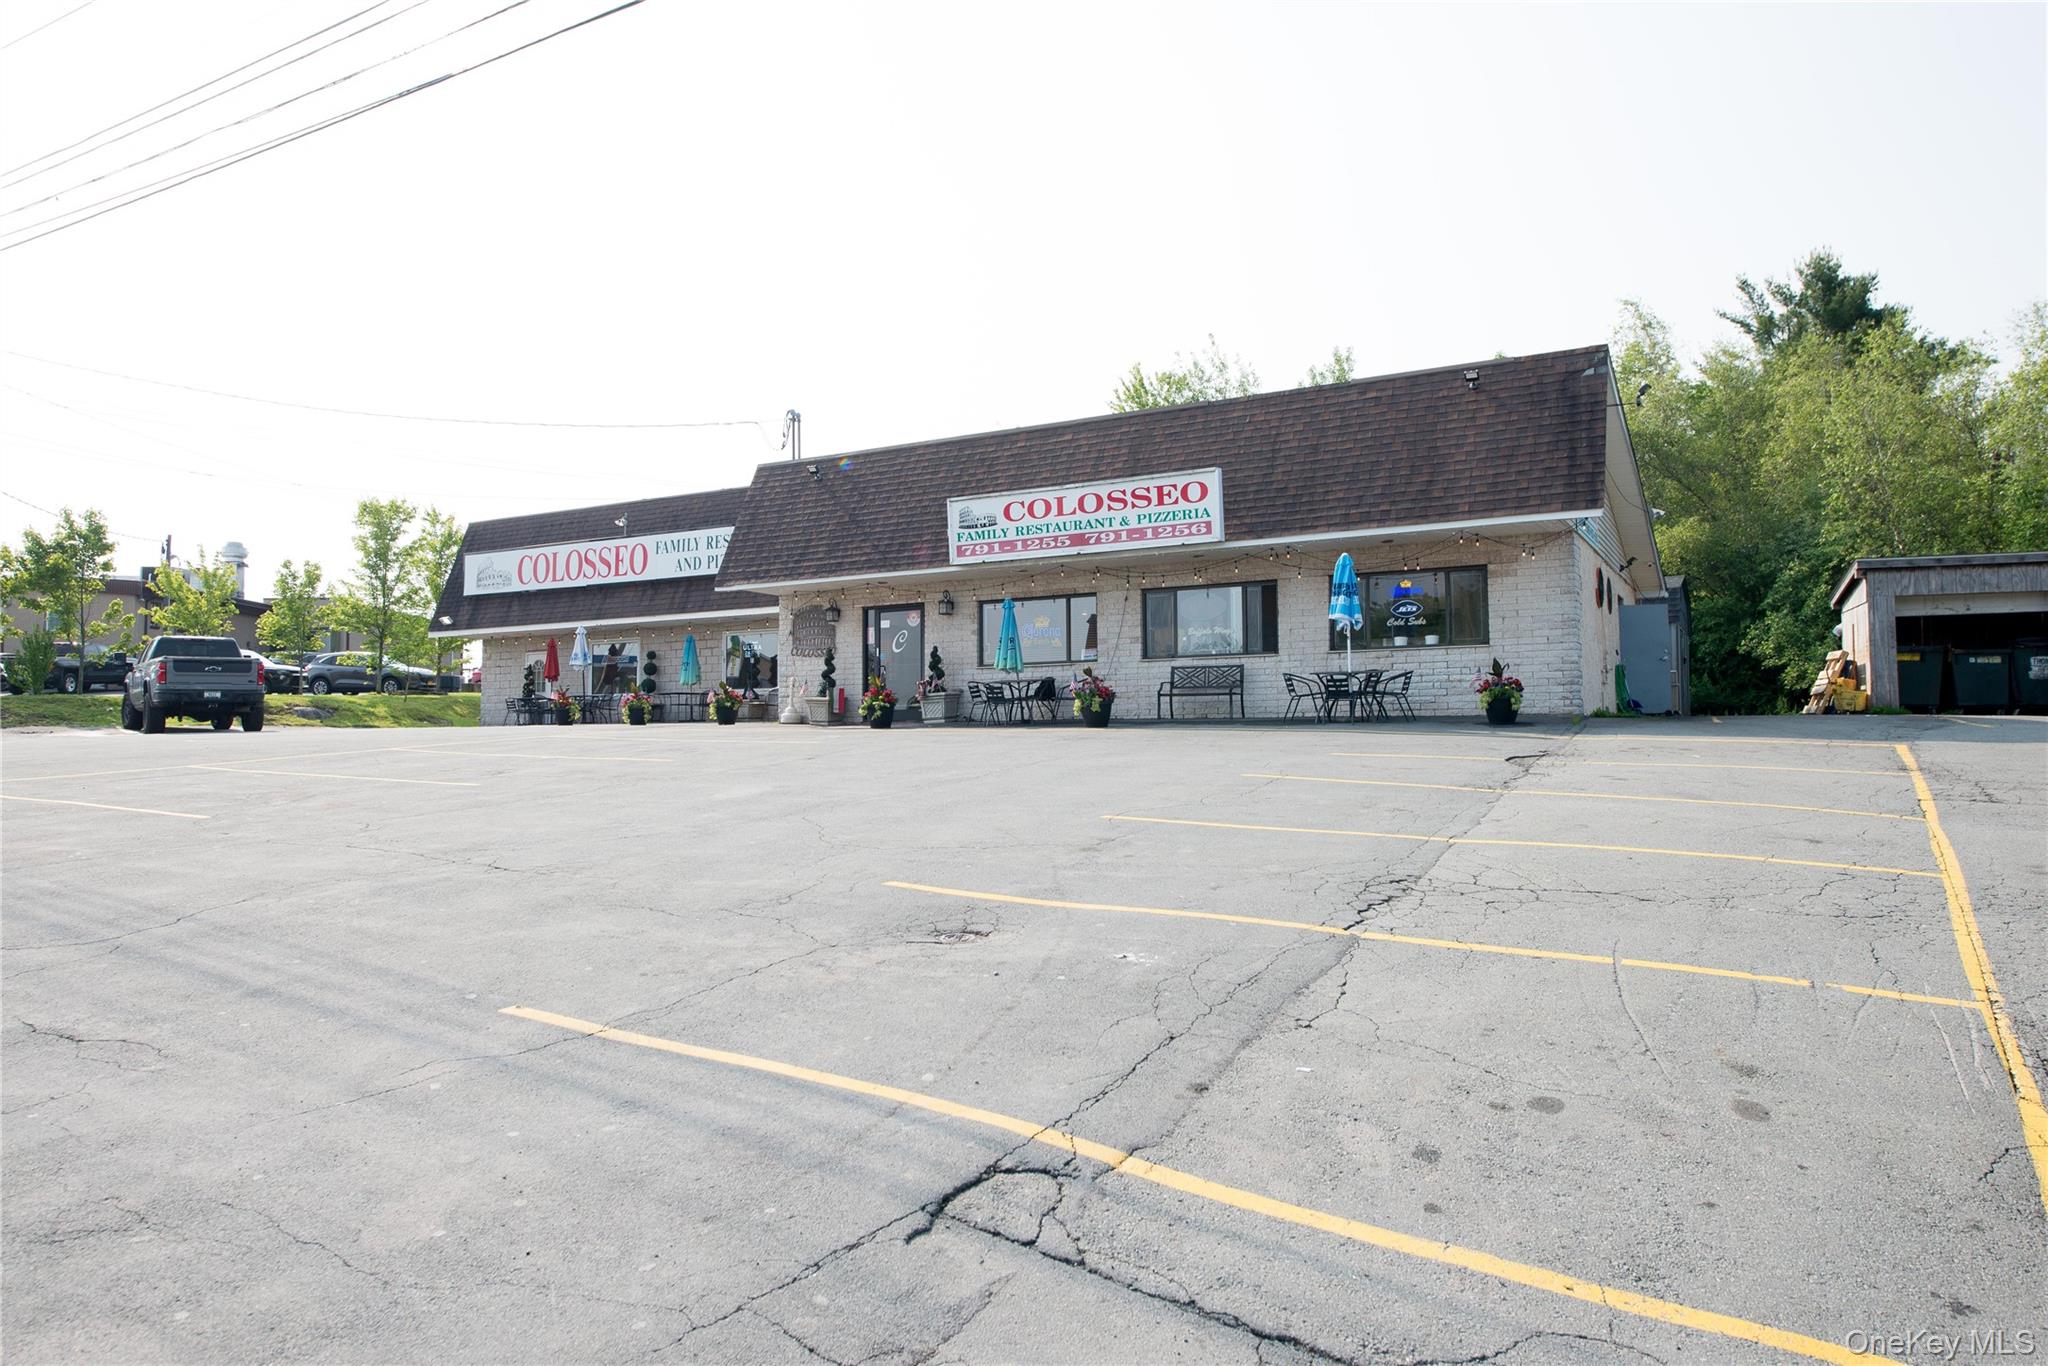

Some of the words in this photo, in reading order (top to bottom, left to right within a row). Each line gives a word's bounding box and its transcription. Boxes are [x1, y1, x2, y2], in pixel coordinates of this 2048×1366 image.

[1003, 481, 1208, 522] COLOSSEO
[957, 528, 1010, 542] FAMILY
[1016, 516, 1115, 536] RESTAURANT
[1119, 515, 1130, 526] &
[1137, 507, 1211, 524] PIZZERIA
[961, 536, 1071, 556] 791-1255
[1084, 523, 1207, 543] 791-1256
[656, 537, 701, 555] FAMILY
[517, 543, 648, 585] COLOSSEO
[675, 556, 702, 572] AND
